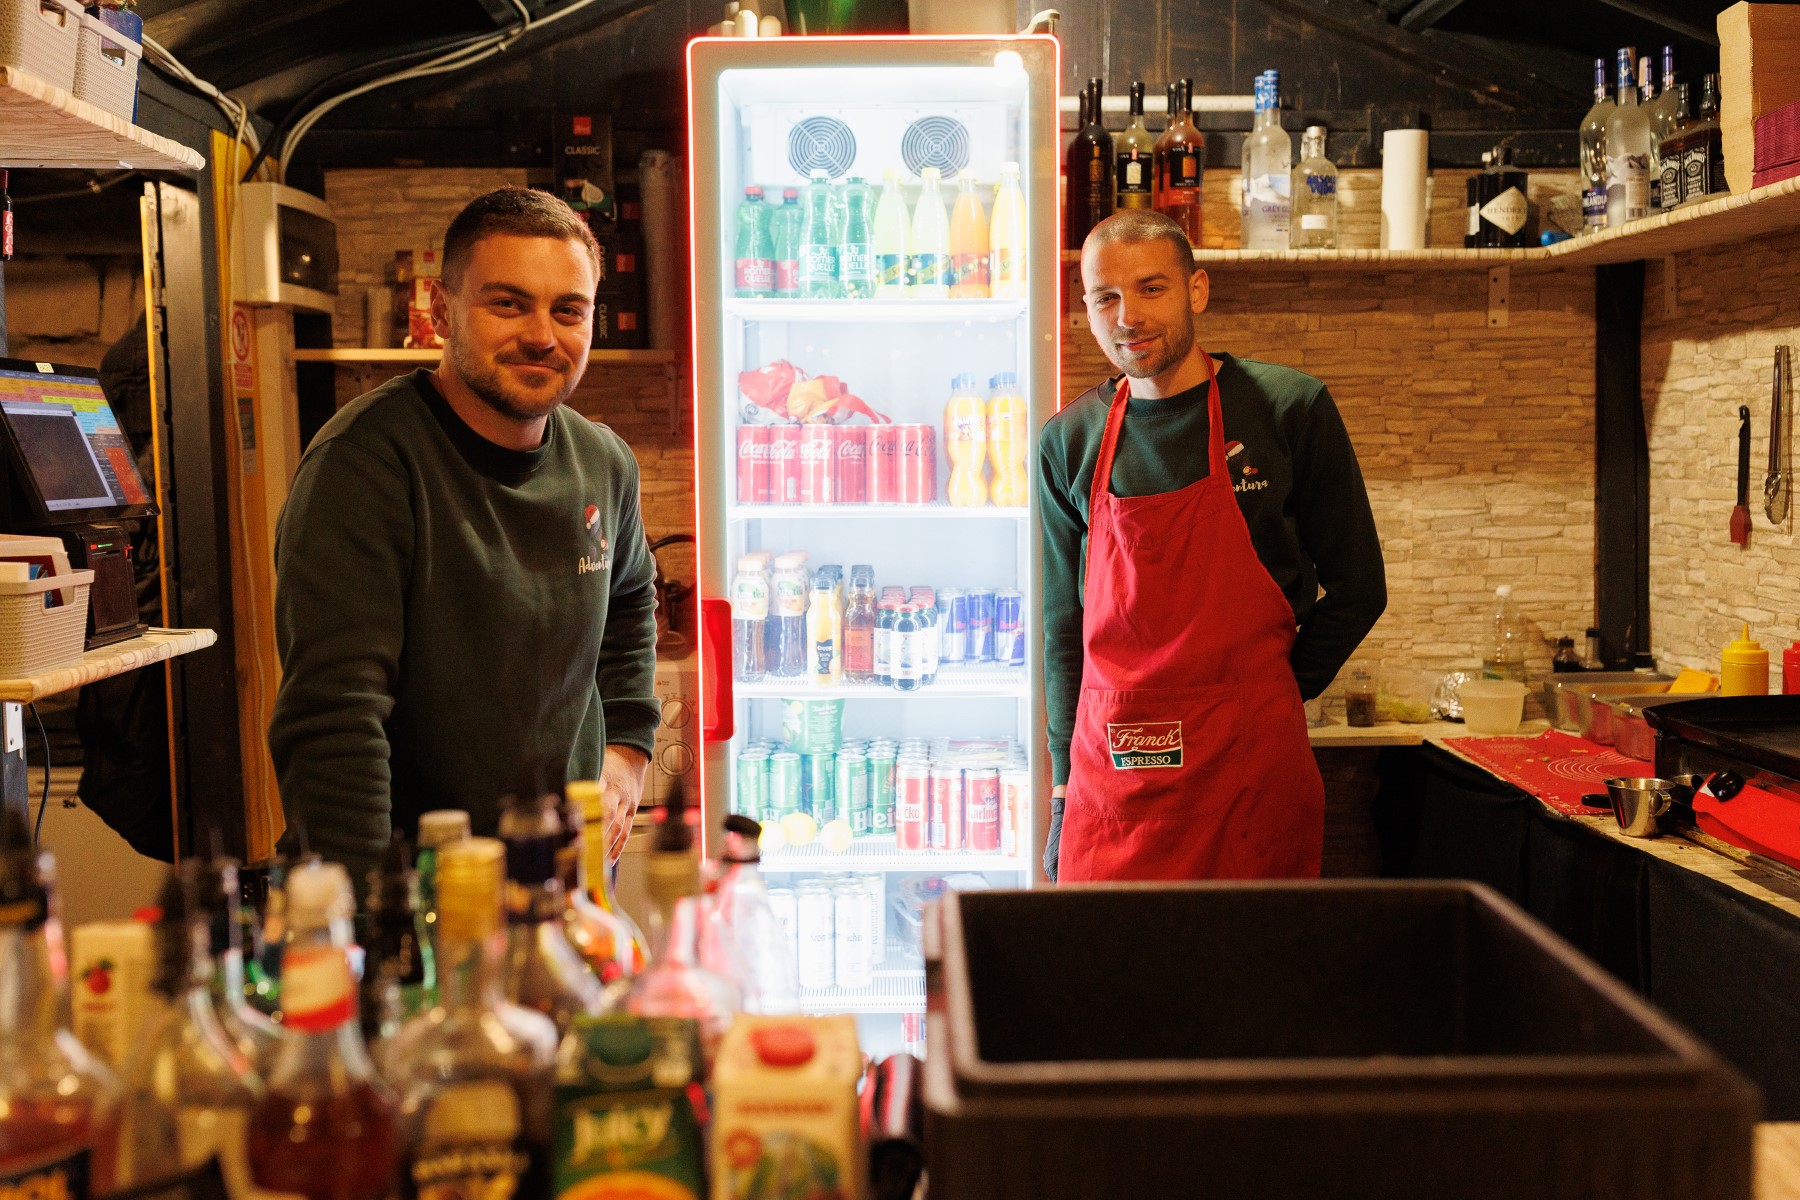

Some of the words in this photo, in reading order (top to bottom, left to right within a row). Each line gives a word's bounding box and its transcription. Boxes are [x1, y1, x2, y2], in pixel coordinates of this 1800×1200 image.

[564, 145, 601, 156] CLASSIC
[599, 303, 608, 340] CLASSIC
[1112, 727, 1180, 748] Franck
[1120, 755, 1171, 767] ESPRESSO
